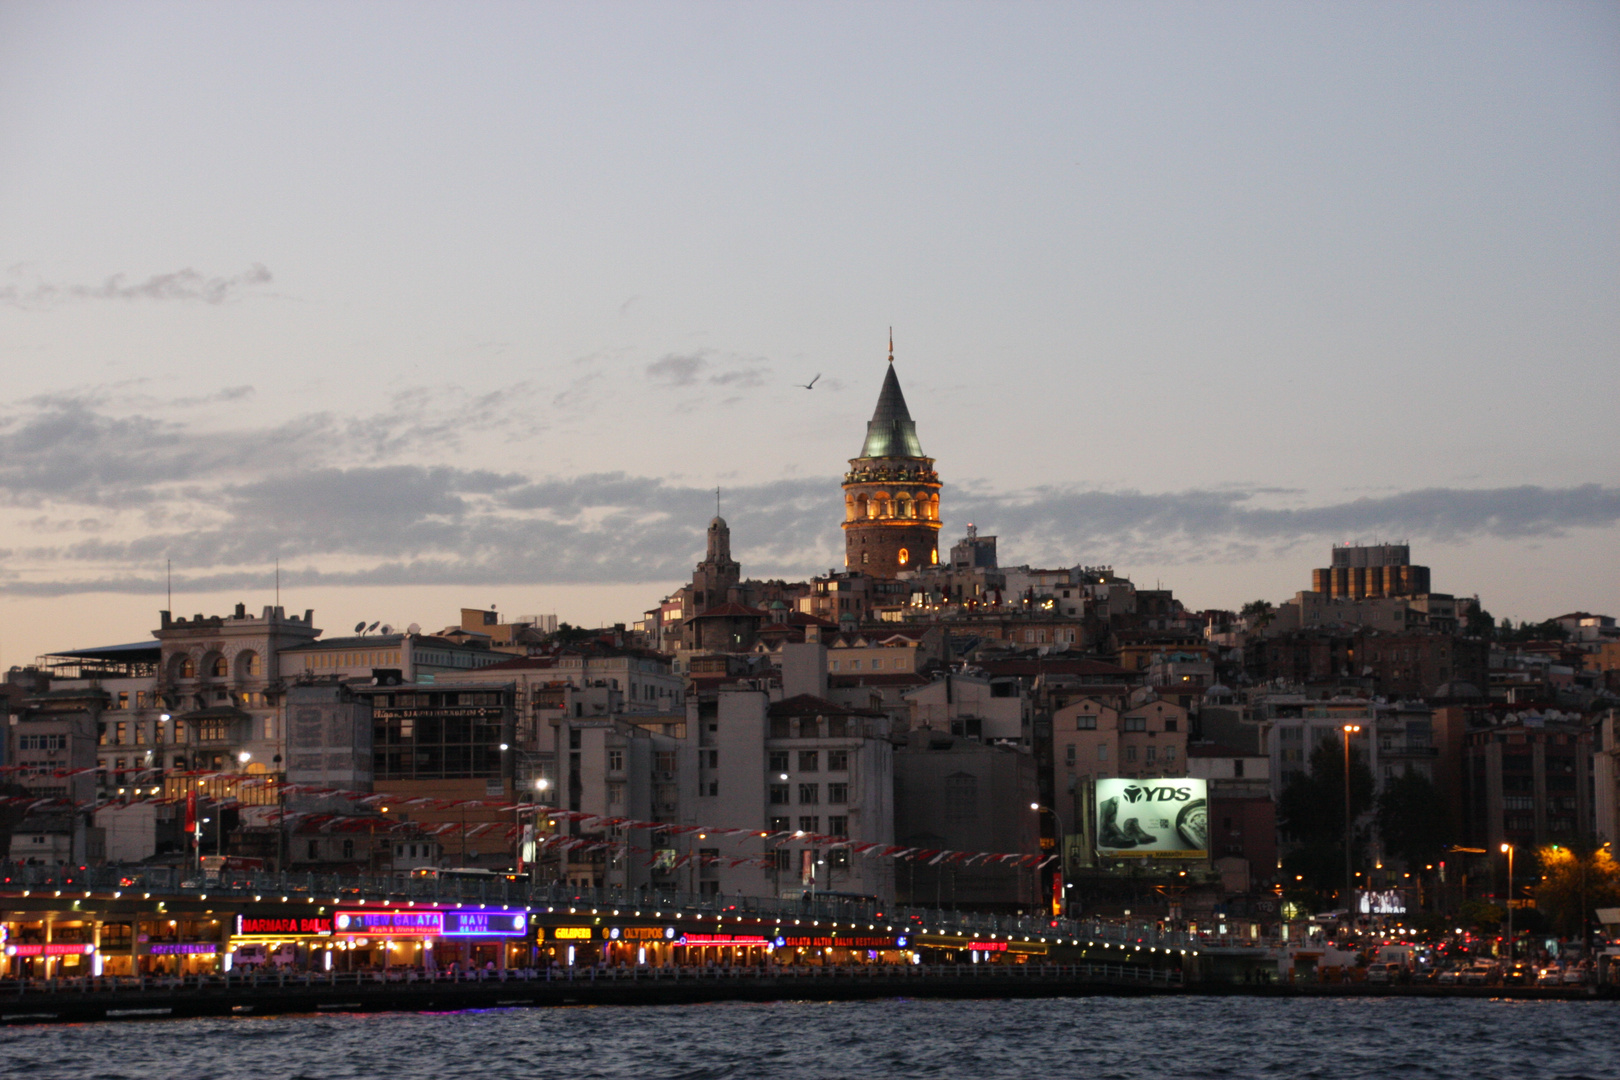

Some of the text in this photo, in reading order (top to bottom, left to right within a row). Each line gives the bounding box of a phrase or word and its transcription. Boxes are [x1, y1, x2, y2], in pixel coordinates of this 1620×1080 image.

[1143, 787, 1191, 801] YDS
[243, 918, 298, 932] MARMARA
[301, 918, 331, 932] BALIK
[364, 914, 439, 926] NEW GALATA
[786, 937, 811, 946] GALATA
[834, 937, 854, 946] BALIK
[855, 937, 896, 946] RESTAURANT
